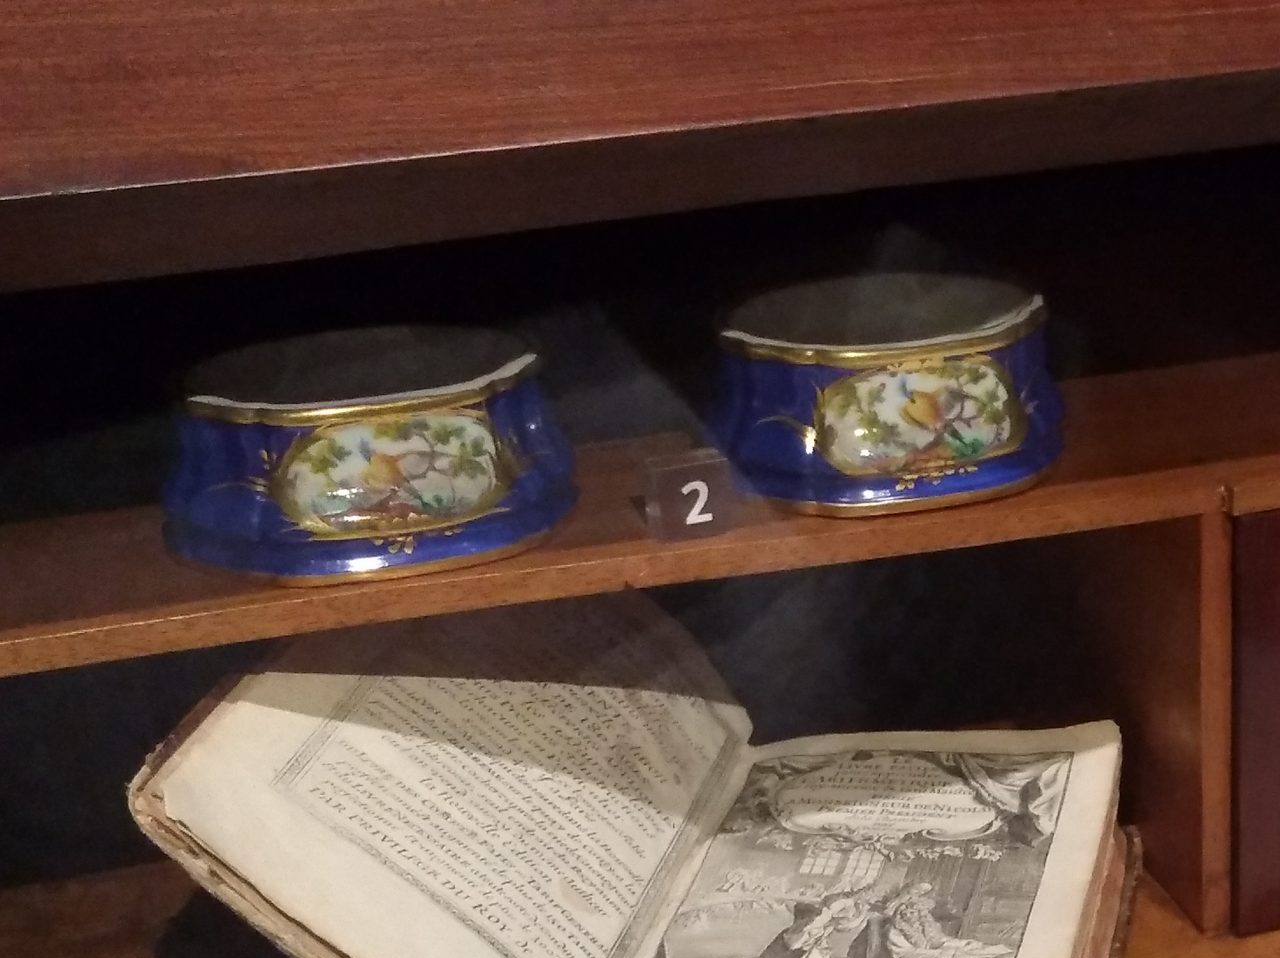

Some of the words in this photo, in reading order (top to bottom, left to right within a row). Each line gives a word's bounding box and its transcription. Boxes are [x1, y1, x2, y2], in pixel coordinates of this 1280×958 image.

[680, 479, 713, 525] 2
[307, 786, 347, 814] PAR
[440, 879, 472, 900] DU
